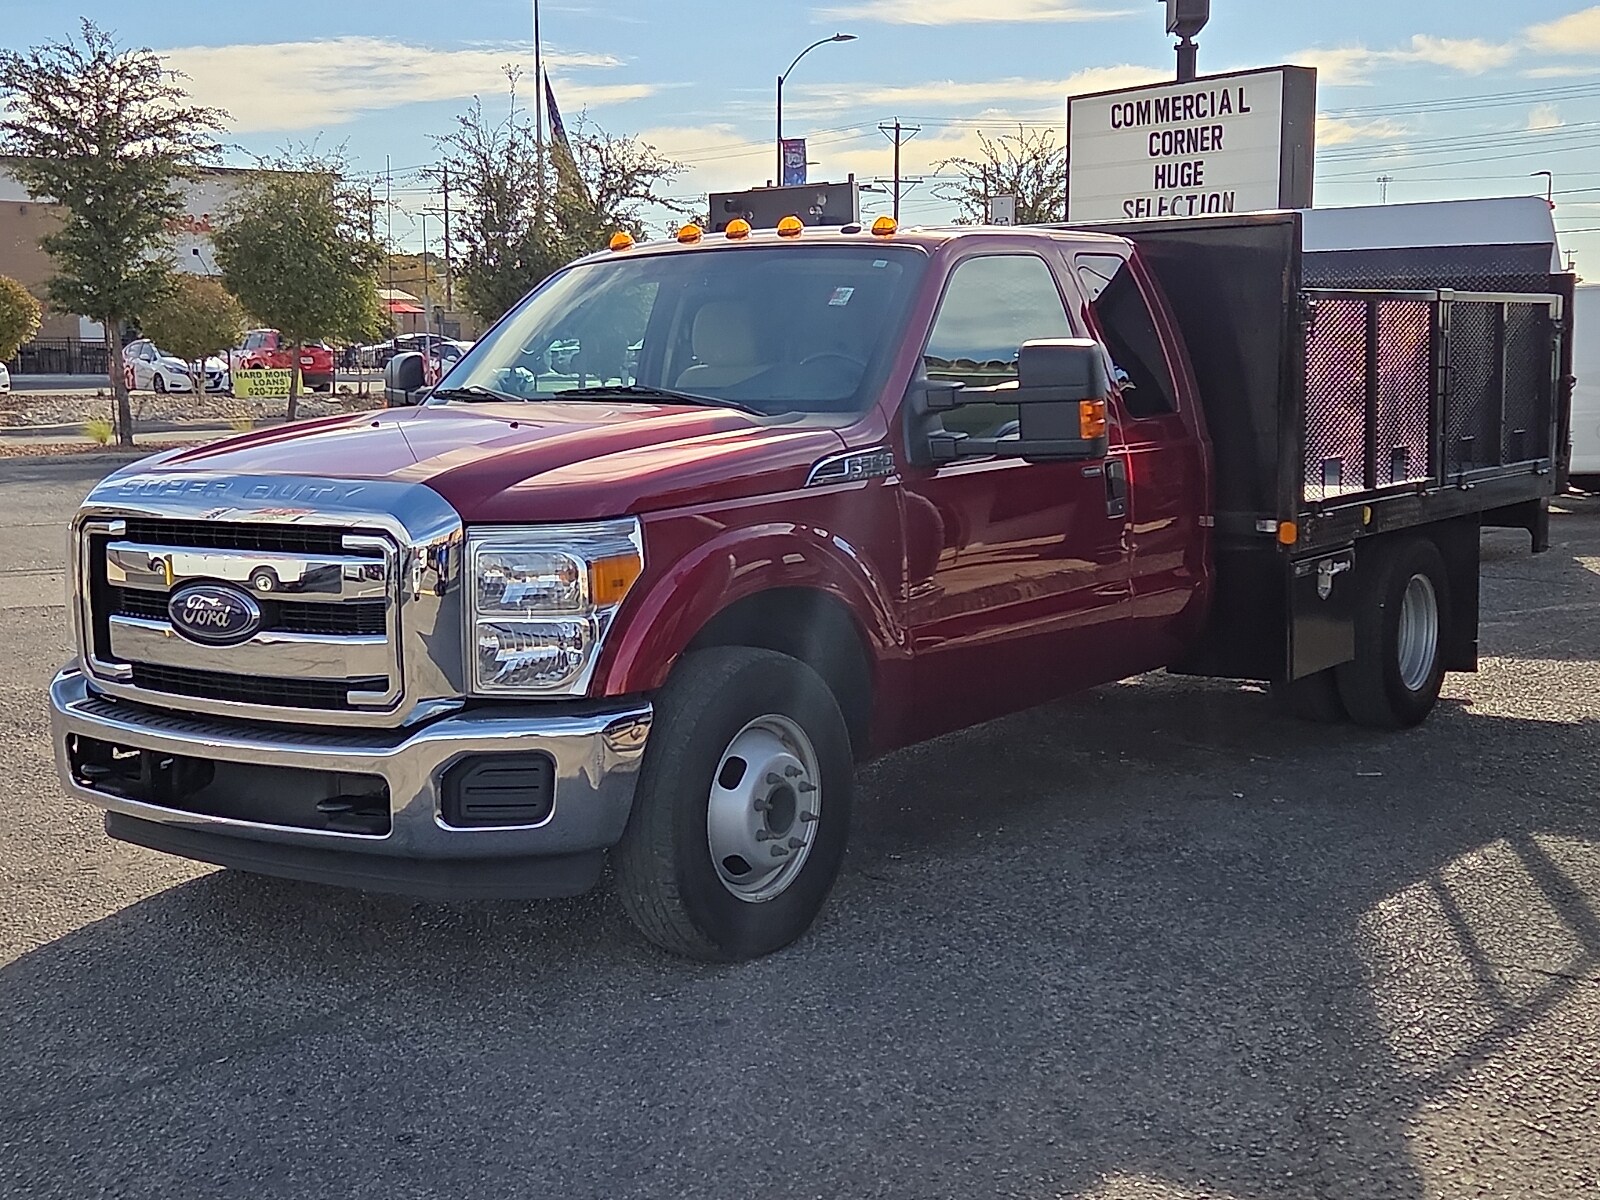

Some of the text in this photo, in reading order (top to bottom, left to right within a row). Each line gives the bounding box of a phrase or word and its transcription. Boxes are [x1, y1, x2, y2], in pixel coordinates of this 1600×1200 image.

[1111, 87, 1251, 128] COMMERCIAL
[1149, 124, 1223, 157] CORNER
[1154, 160, 1204, 189] HUGE
[1123, 191, 1235, 218] SELECTION
[235, 371, 262, 379] HARD
[253, 378, 285, 386] LOANS
[118, 479, 366, 501] SUPER DUTY
[182, 594, 231, 627] Ford
